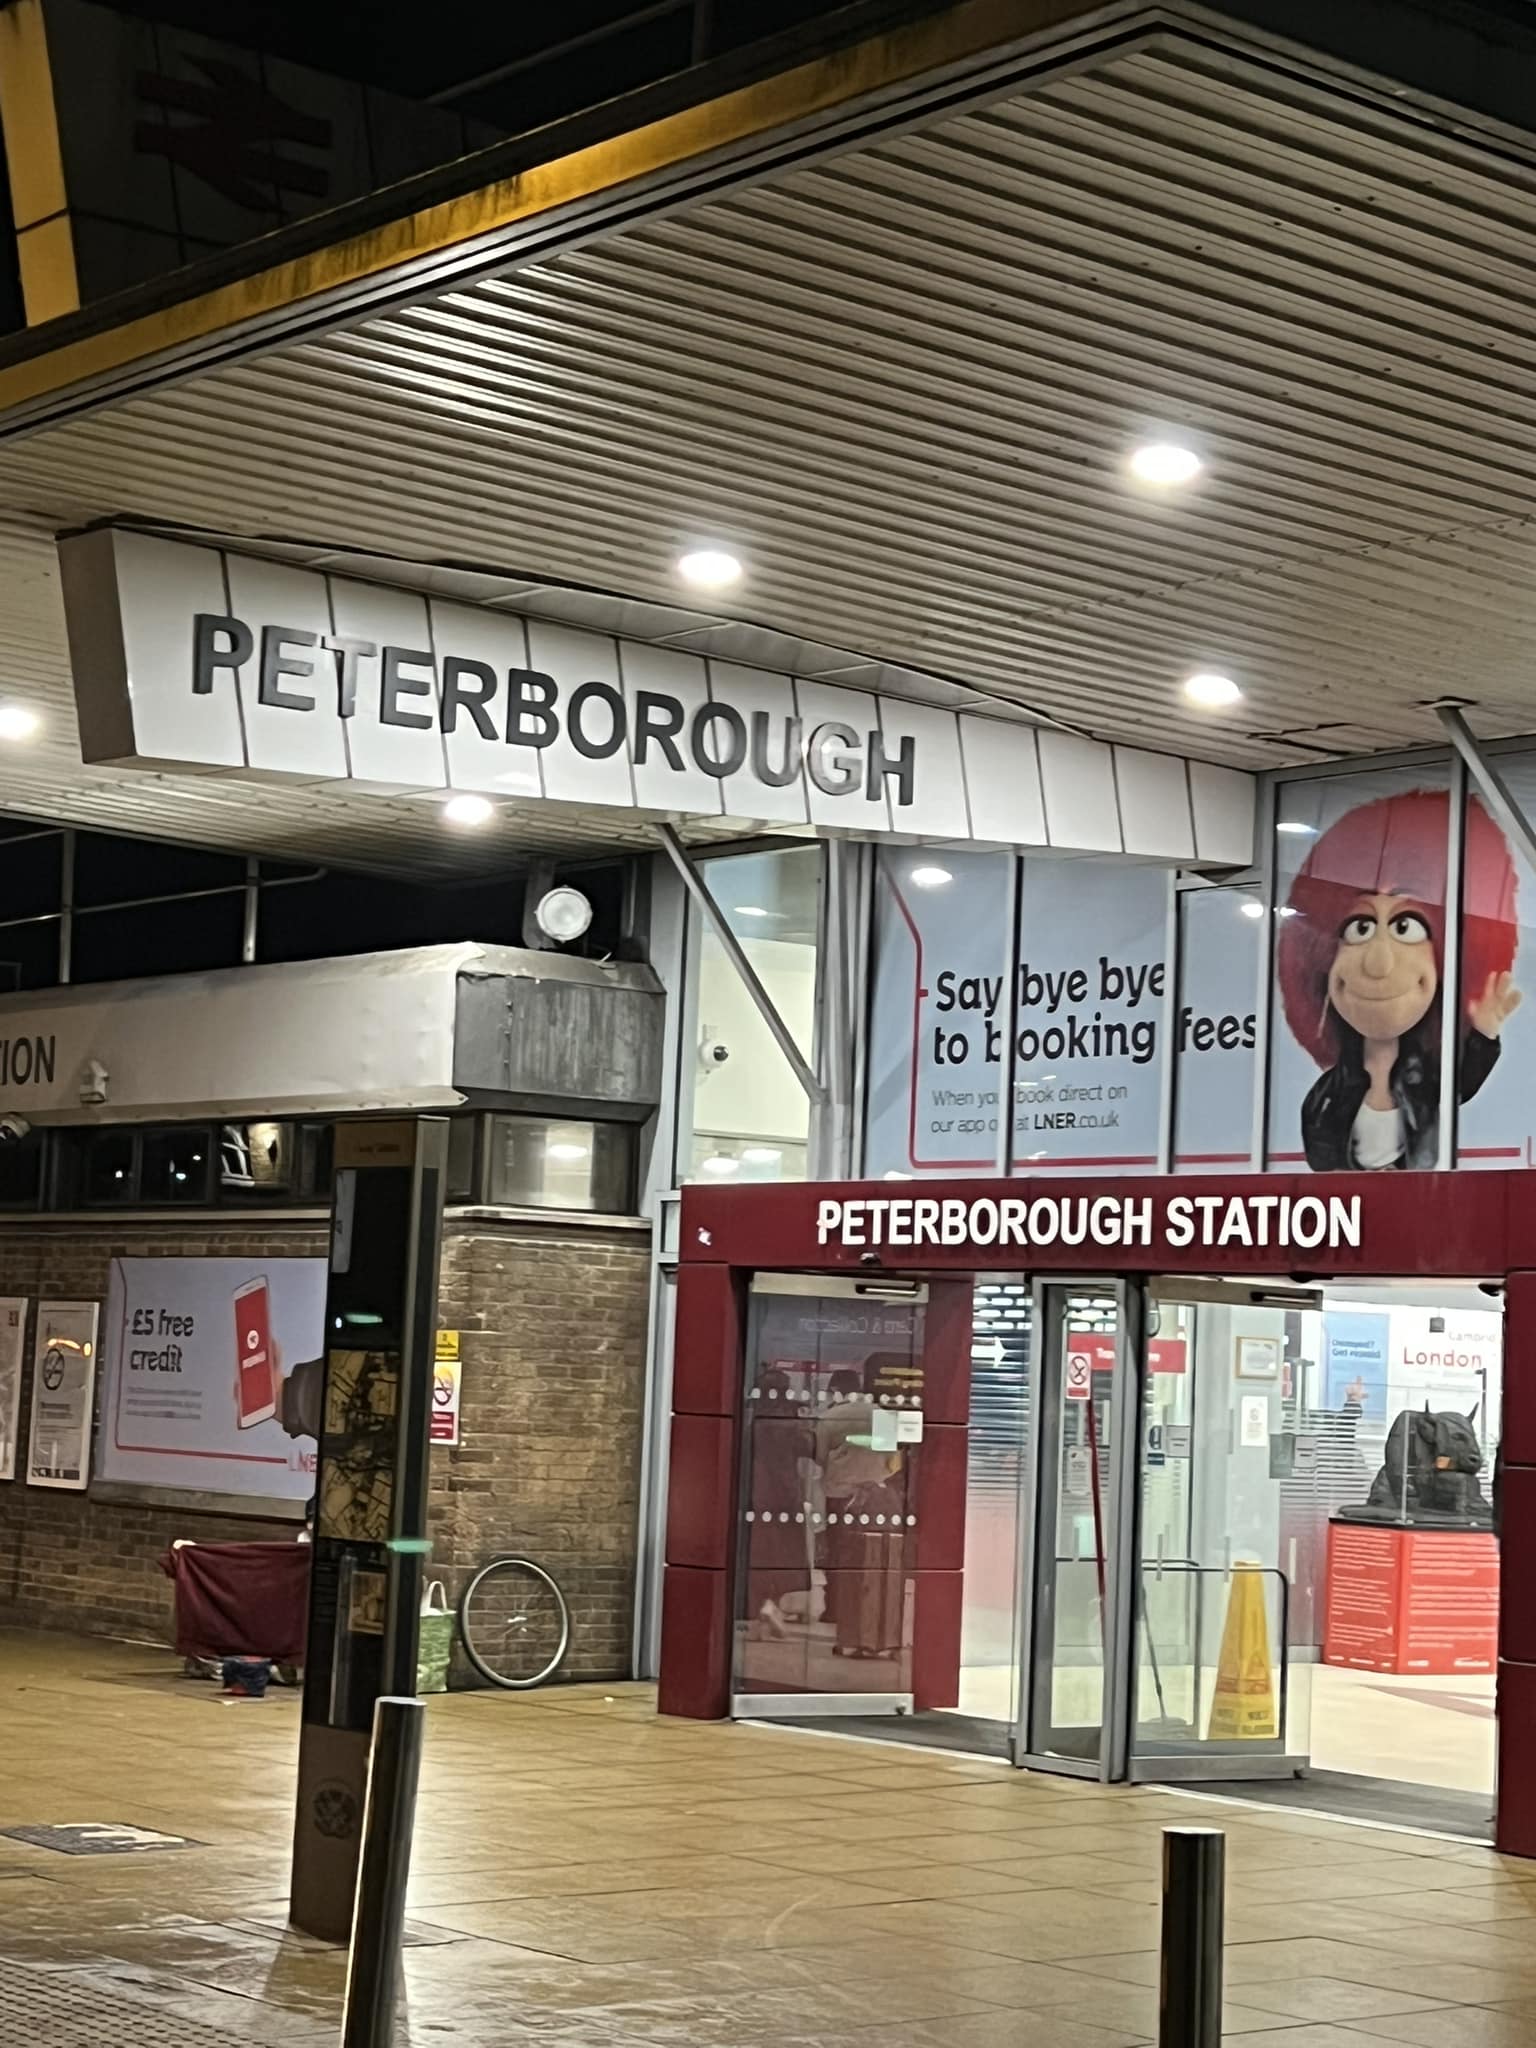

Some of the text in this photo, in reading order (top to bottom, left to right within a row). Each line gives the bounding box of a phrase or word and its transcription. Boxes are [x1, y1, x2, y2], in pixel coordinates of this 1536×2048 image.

[192, 613, 916, 806] PETERBOROUGH
[936, 956, 1165, 1018] Say bye bye
[934, 1006, 1256, 1064] to booking fees
[0, 1034, 56, 1086] ION
[931, 1090, 975, 1107] When
[1015, 1083, 1054, 1105] book
[1058, 1083, 1103, 1102] direct
[1107, 1085, 1128, 1100] on
[931, 1119, 954, 1133] our
[957, 1119, 985, 1134] app
[1034, 1110, 1120, 1130] LNER.co.uk
[817, 1196, 1362, 1248] PETERBOROUGH STATION
[131, 1308, 194, 1337] £5 free
[129, 1343, 183, 1373] credit
[1403, 1346, 1482, 1368] London
